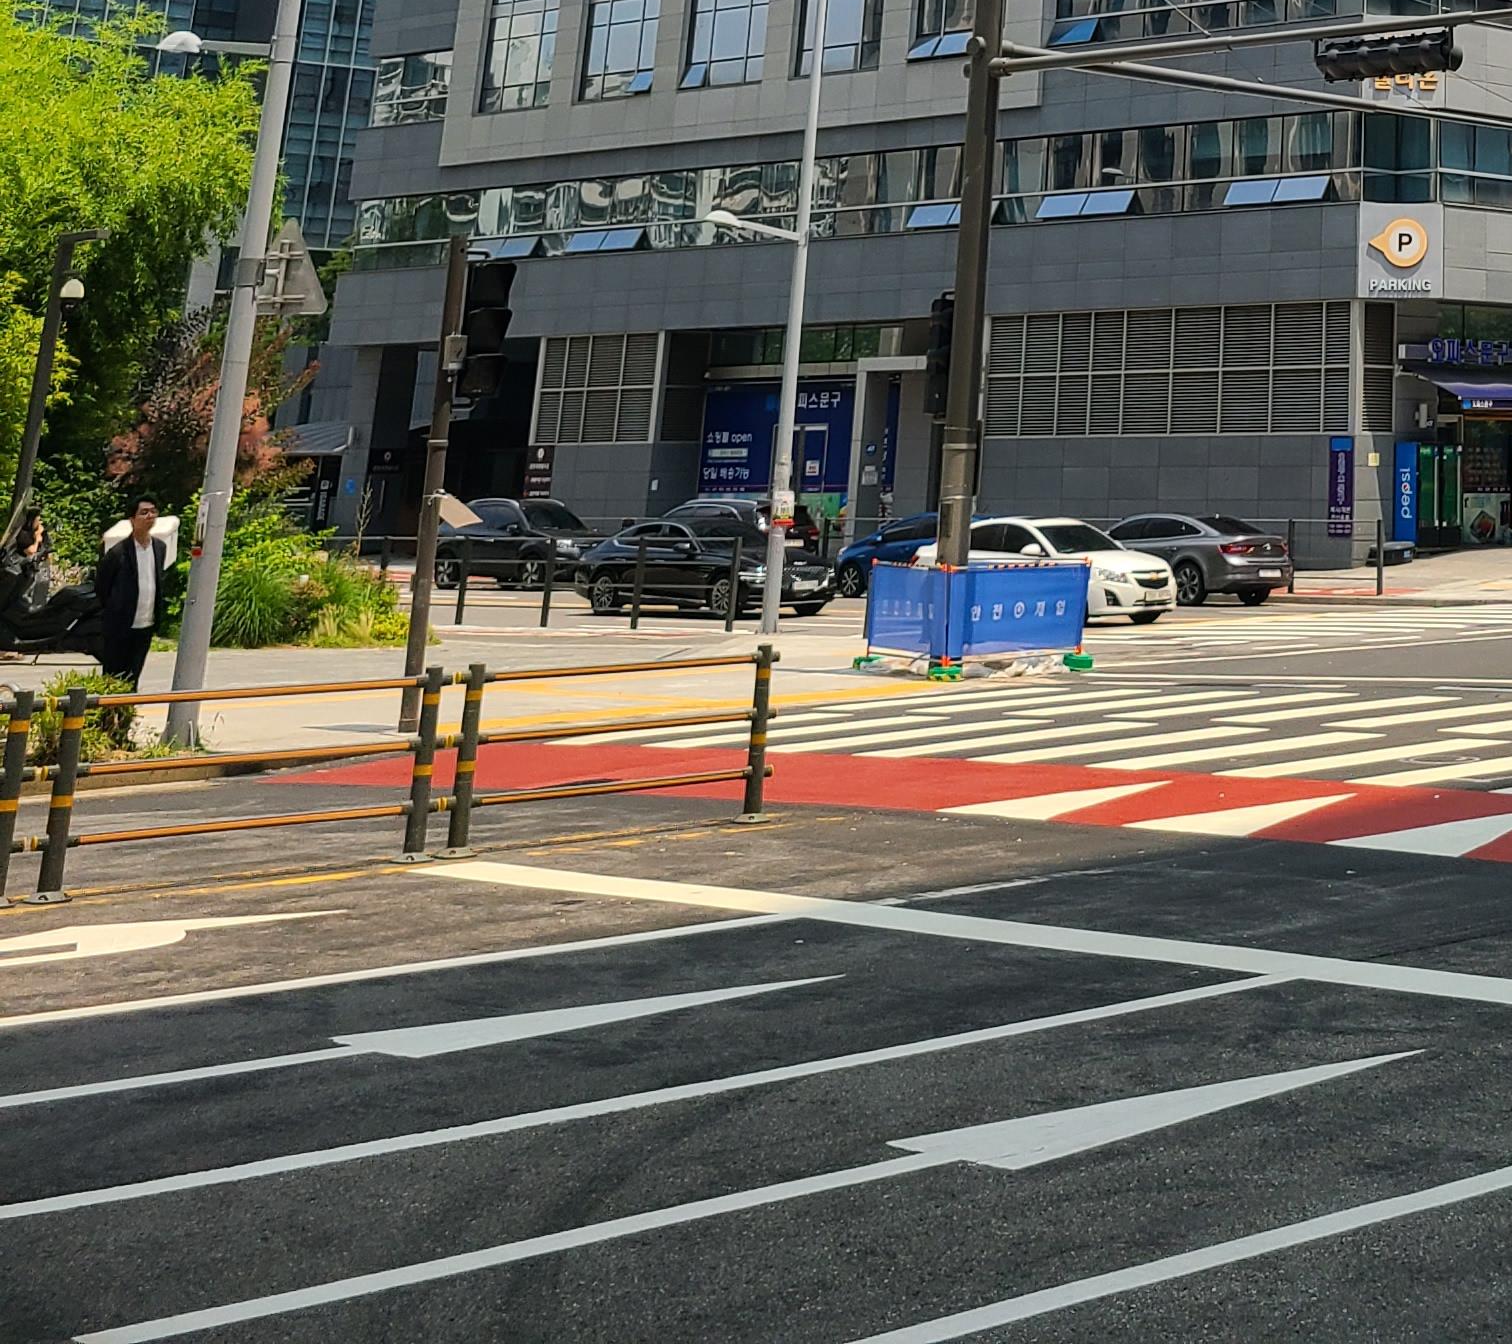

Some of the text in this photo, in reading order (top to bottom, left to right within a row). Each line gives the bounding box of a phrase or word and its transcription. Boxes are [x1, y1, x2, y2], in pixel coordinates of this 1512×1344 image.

[1398, 233, 1413, 252] P
[1369, 279, 1432, 292] PARKING
[1430, 338, 1510, 363] 오피스문구
[797, 391, 842, 409] 피스문구
[731, 433, 753, 444] open
[1400, 467, 1413, 519] pepsi
